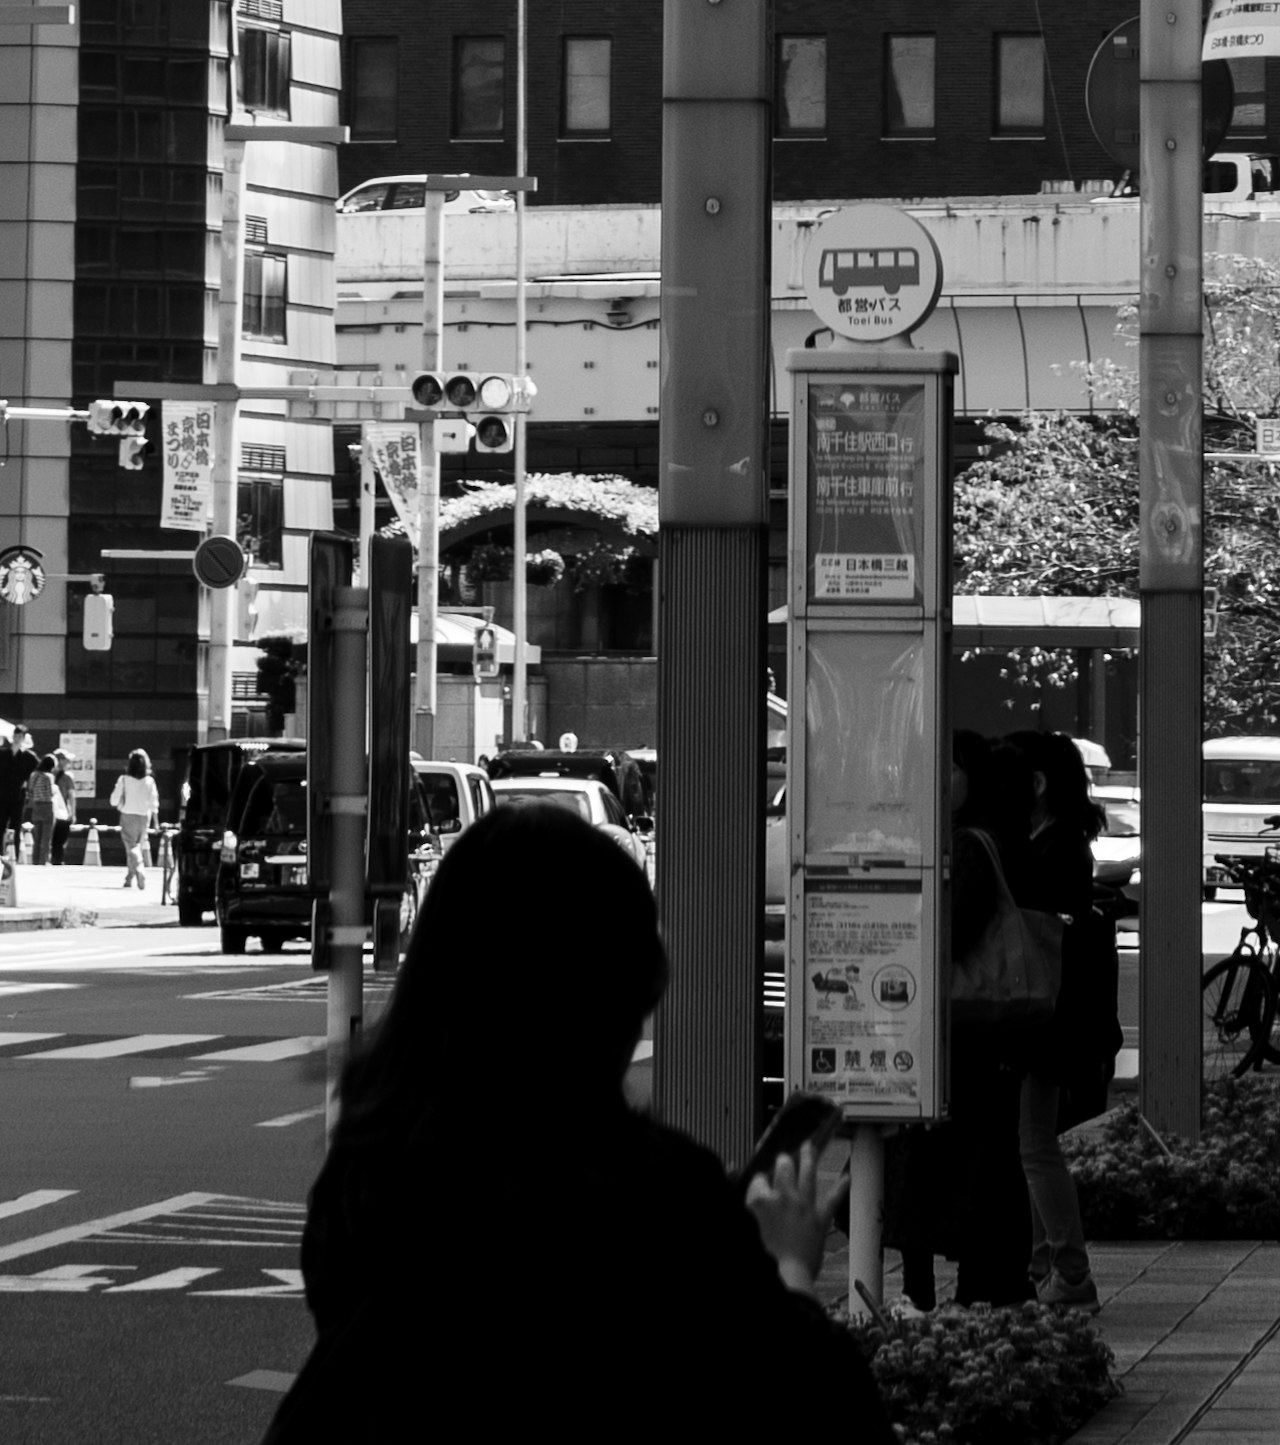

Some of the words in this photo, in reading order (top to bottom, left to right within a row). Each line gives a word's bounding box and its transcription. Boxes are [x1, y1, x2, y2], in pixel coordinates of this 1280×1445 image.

[848, 315, 870, 325] Toei
[874, 315, 894, 325] Bus
[166, 421, 181, 469] まつり
[181, 416, 195, 452] 京橋
[196, 412, 210, 466] 日本橋
[400, 435, 418, 490] 日本橋
[845, 558, 908, 572] 日本橋三越
